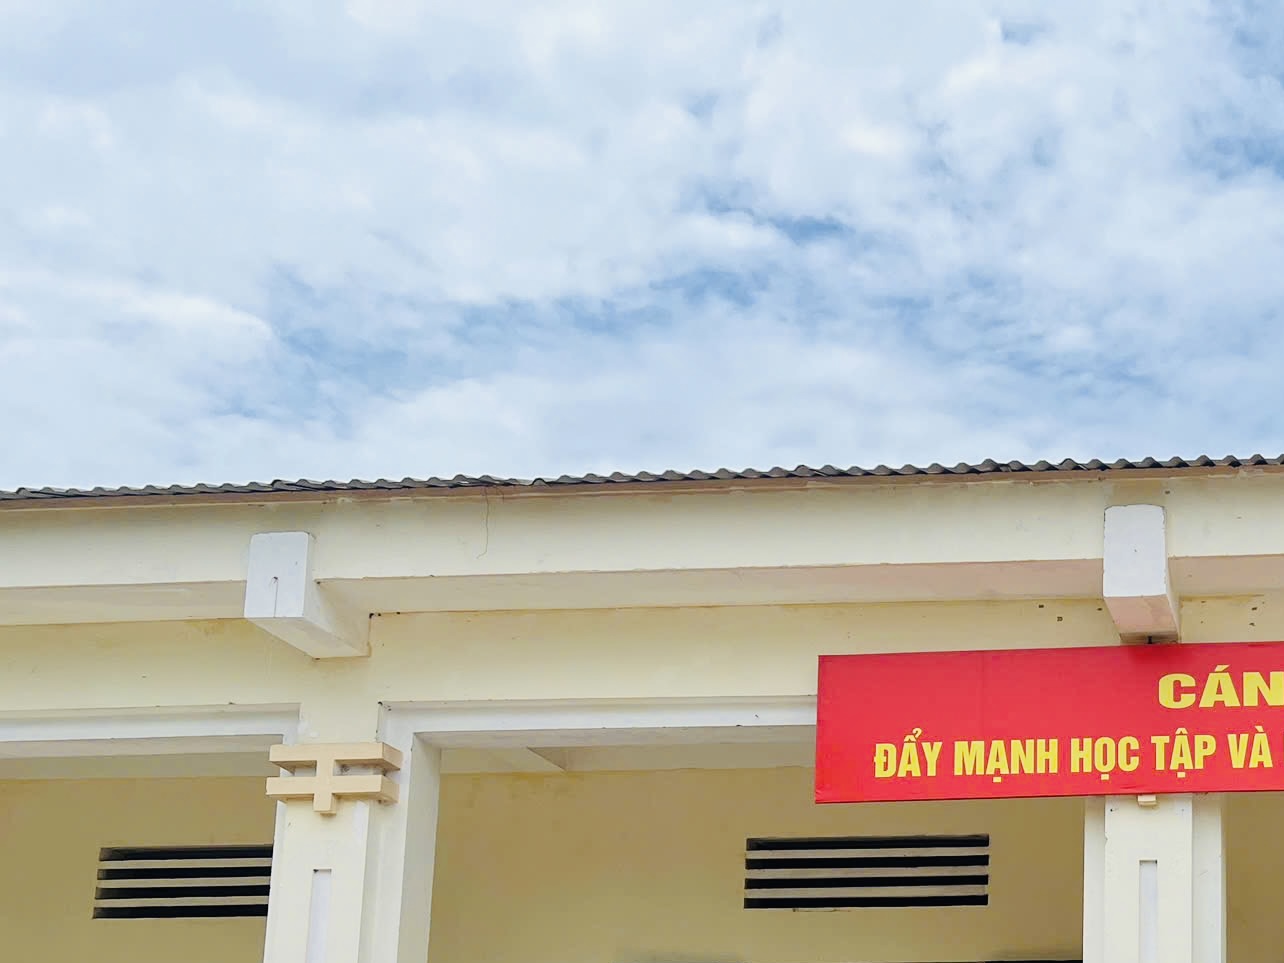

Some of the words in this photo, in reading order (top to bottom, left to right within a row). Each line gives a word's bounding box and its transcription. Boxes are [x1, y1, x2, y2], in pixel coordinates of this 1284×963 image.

[873, 727, 940, 778] ĐẨY
[954, 738, 1058, 784] MẠNH
[1070, 735, 1140, 781] HỌC
[1150, 728, 1217, 779] TẬP
[1228, 726, 1274, 769] VÀ
